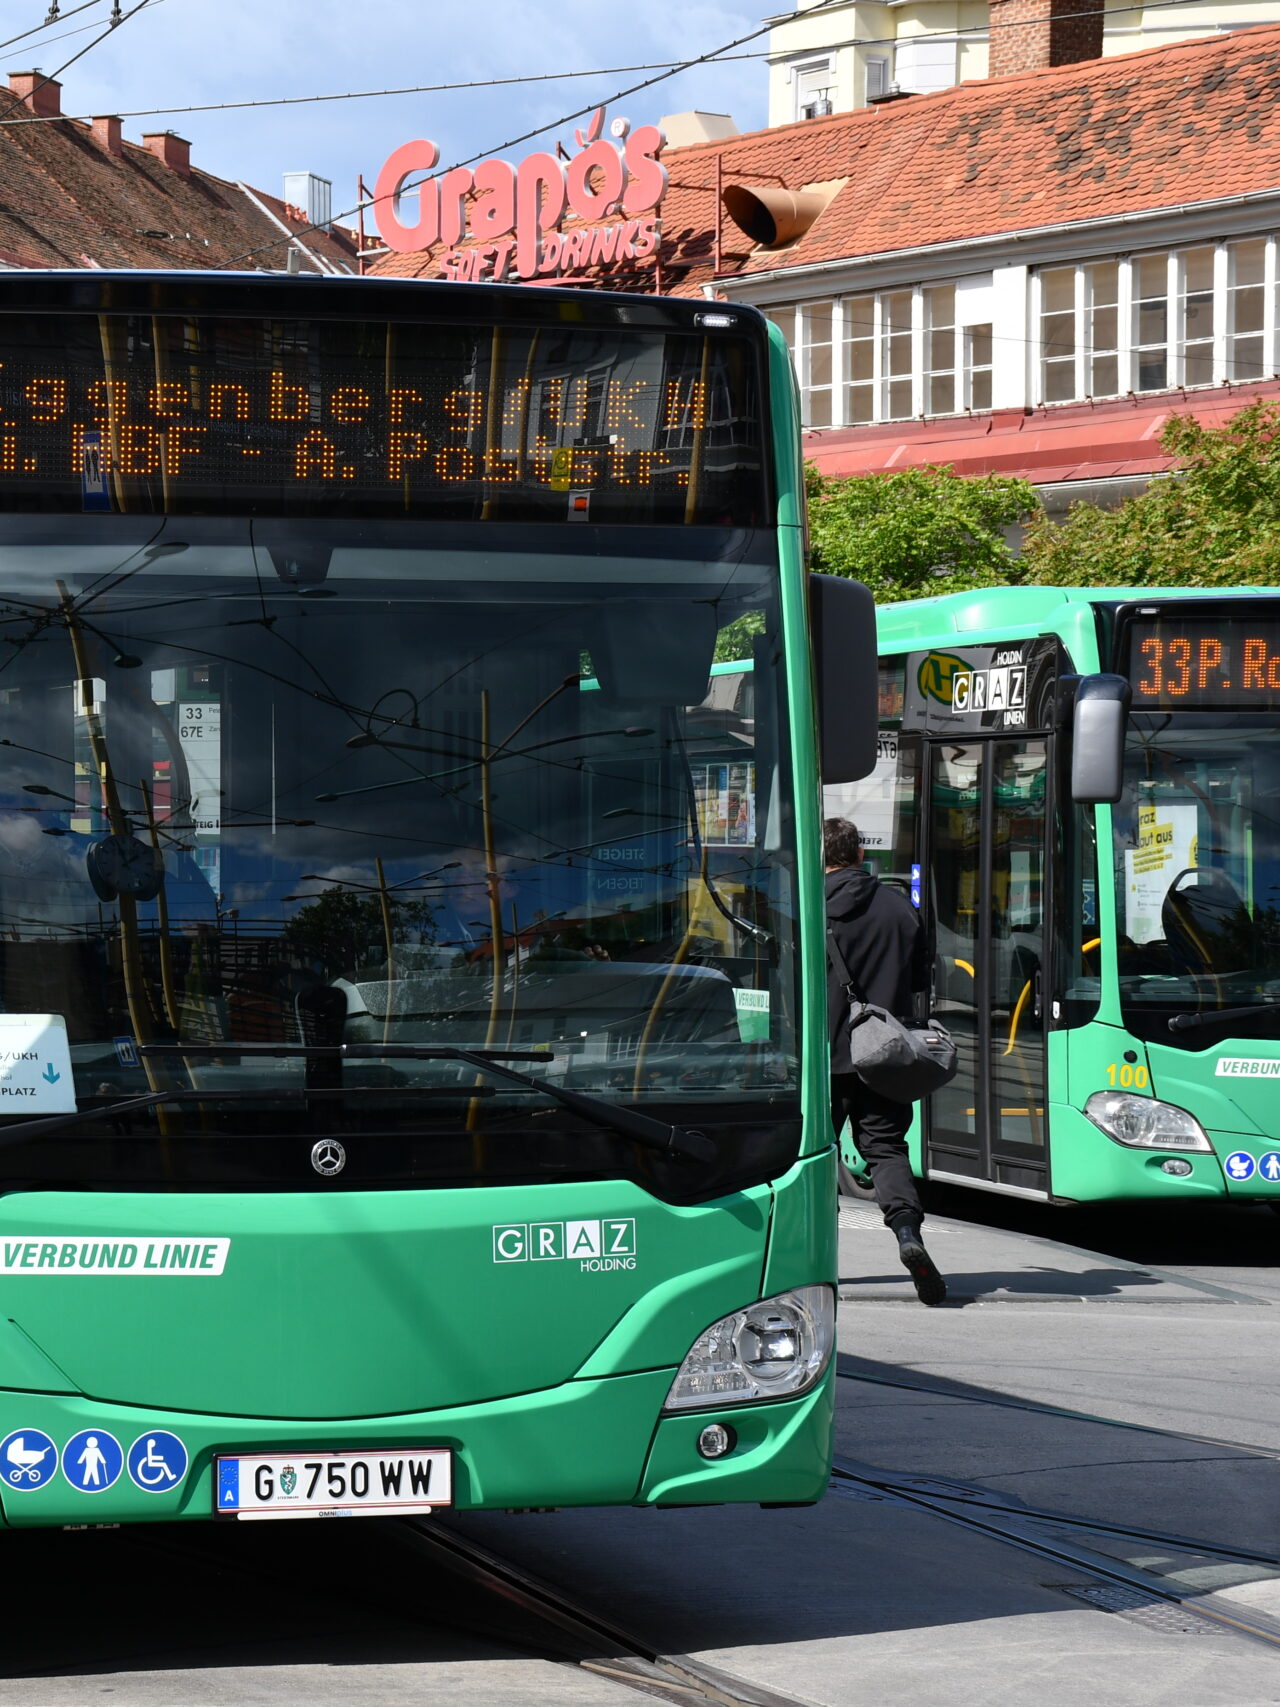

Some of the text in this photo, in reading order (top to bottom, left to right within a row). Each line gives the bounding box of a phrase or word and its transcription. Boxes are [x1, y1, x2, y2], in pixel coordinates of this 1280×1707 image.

[440, 219, 659, 281] SOFT DRINKS
[72, 424, 208, 474] HBF
[295, 429, 355, 478] A.
[389, 432, 689, 484] Poststr.
[1140, 638, 1191, 694] 33
[1199, 638, 1231, 688] P.
[952, 668, 1026, 712] GRAZ
[186, 708, 202, 719] 33
[1003, 711, 1025, 725] LINIEN
[180, 726, 204, 739] 67E
[194, 820, 213, 829] TEIG
[1140, 812, 1156, 824] raz
[1140, 830, 1173, 847] aut aus
[738, 992, 765, 1008] VERBUND
[1106, 1064, 1148, 1088] 100
[495, 1220, 633, 1261] GRAZ
[3, 1243, 218, 1269] VERBUND LINIE
[580, 1257, 637, 1272] HOLDING
[254, 1458, 433, 1501] G 750 WW
[224, 1489, 235, 1501] A
